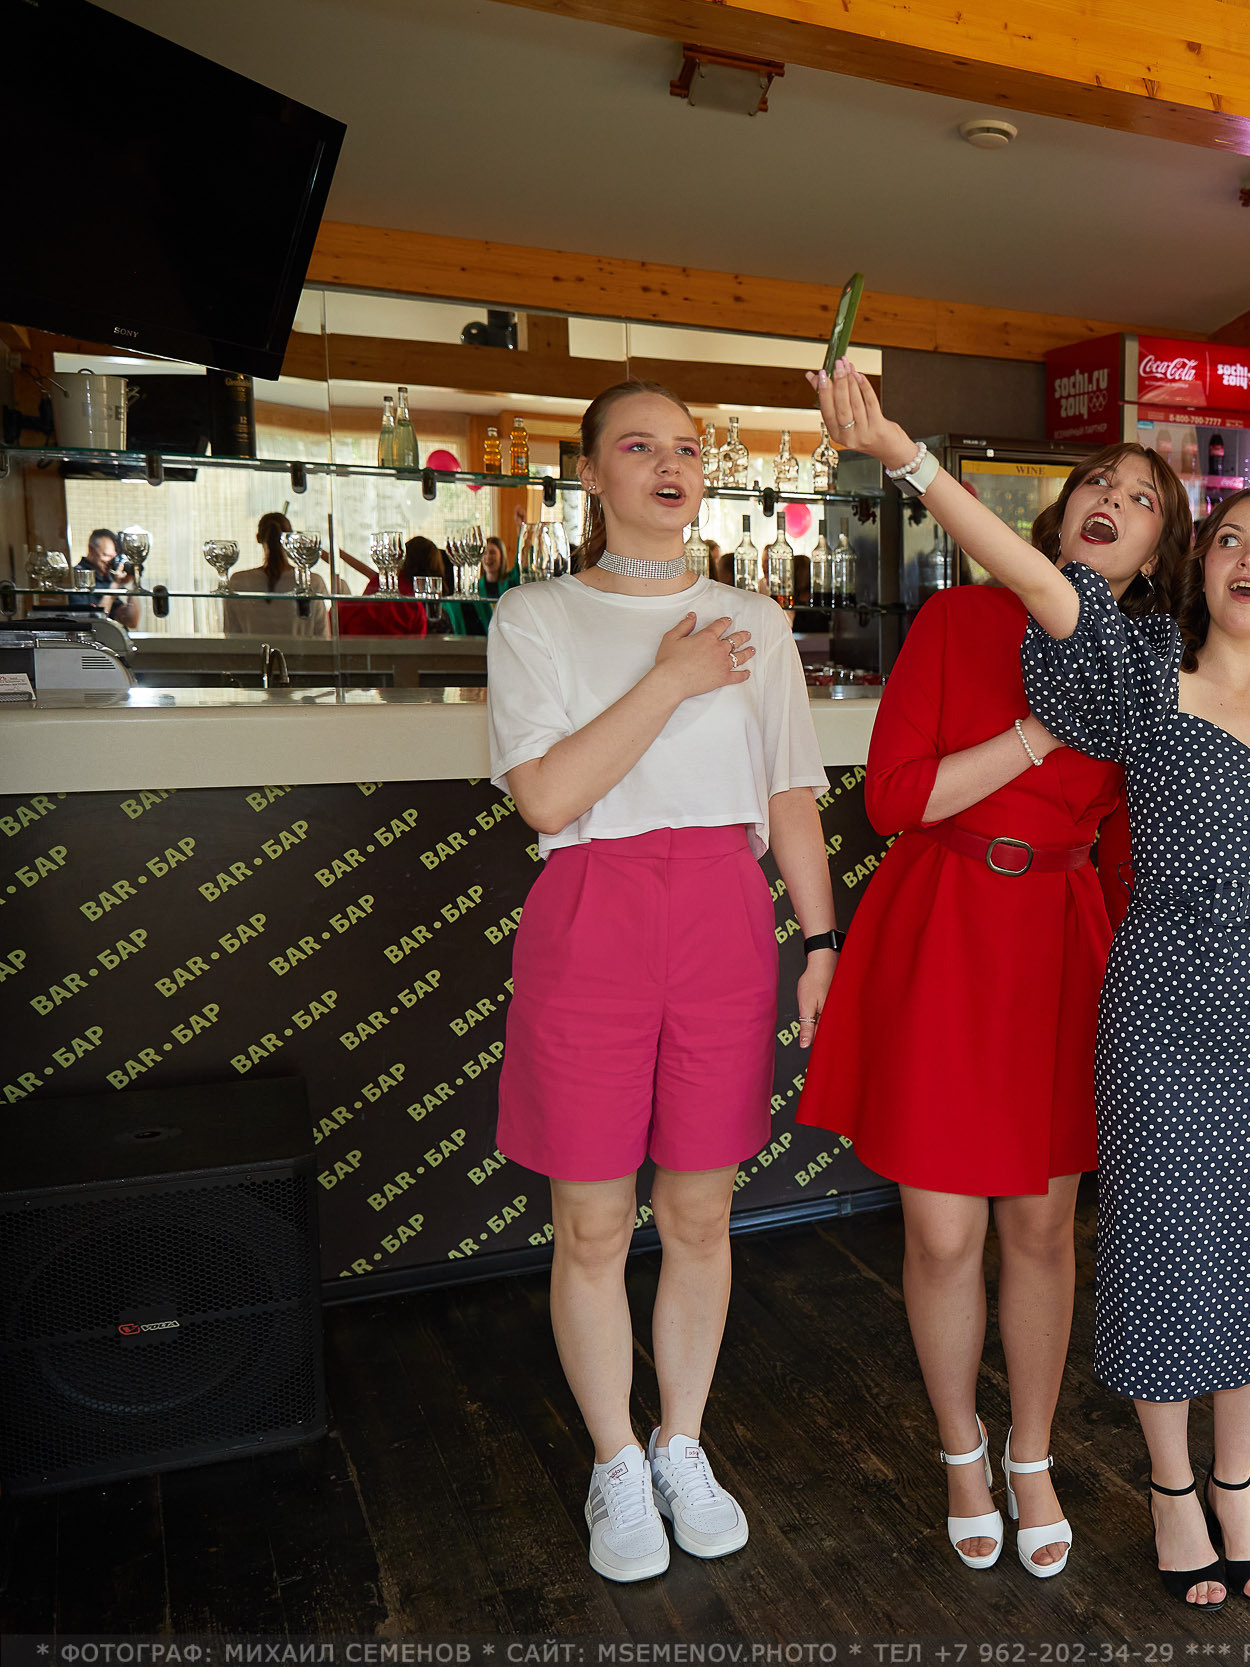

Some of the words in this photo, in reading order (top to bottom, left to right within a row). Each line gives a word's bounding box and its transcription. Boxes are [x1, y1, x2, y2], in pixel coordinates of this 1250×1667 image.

[113, 326, 139, 338] SONY
[1054, 368, 1108, 399] sochi.ru
[1139, 355, 1199, 381] Coca-Cola
[1016, 465, 1046, 475] WINE
[0, 795, 57, 837] BAR
[15, 845, 68, 888] БАР
[197, 861, 254, 903] BAR
[260, 820, 309, 860] БАР
[314, 848, 367, 888] BAR
[373, 808, 419, 848] БАР
[419, 831, 469, 871] BAR
[79, 879, 138, 921] BAR
[145, 837, 196, 878] БАР
[842, 854, 879, 889] BAR
[268, 935, 321, 977] BAR
[328, 894, 375, 934] БАР
[383, 925, 433, 965] BAR
[440, 885, 483, 924] БАР
[29, 973, 89, 1016] BAR
[96, 928, 148, 971] БАР
[154, 956, 211, 998] BAR
[217, 913, 267, 954] БАР
[339, 1010, 391, 1051] BAR
[397, 969, 440, 1009] БАР
[449, 998, 497, 1037] BAR
[52, 1025, 104, 1069] БАР
[105, 1047, 164, 1089] BAR
[170, 1003, 220, 1045] БАР
[230, 1032, 285, 1074] BAR
[291, 989, 338, 1031] БАР
[361, 1063, 406, 1103] БАР
[407, 1082, 456, 1122] BAR
[462, 1041, 504, 1080] БАР
[317, 1149, 362, 1190] БАР
[367, 1171, 417, 1212] BAR
[423, 1128, 467, 1168] БАР
[757, 1131, 792, 1167] БАР
[795, 1151, 833, 1187] BAR
[381, 1213, 425, 1254] БАР
[487, 1194, 528, 1233] БАР
